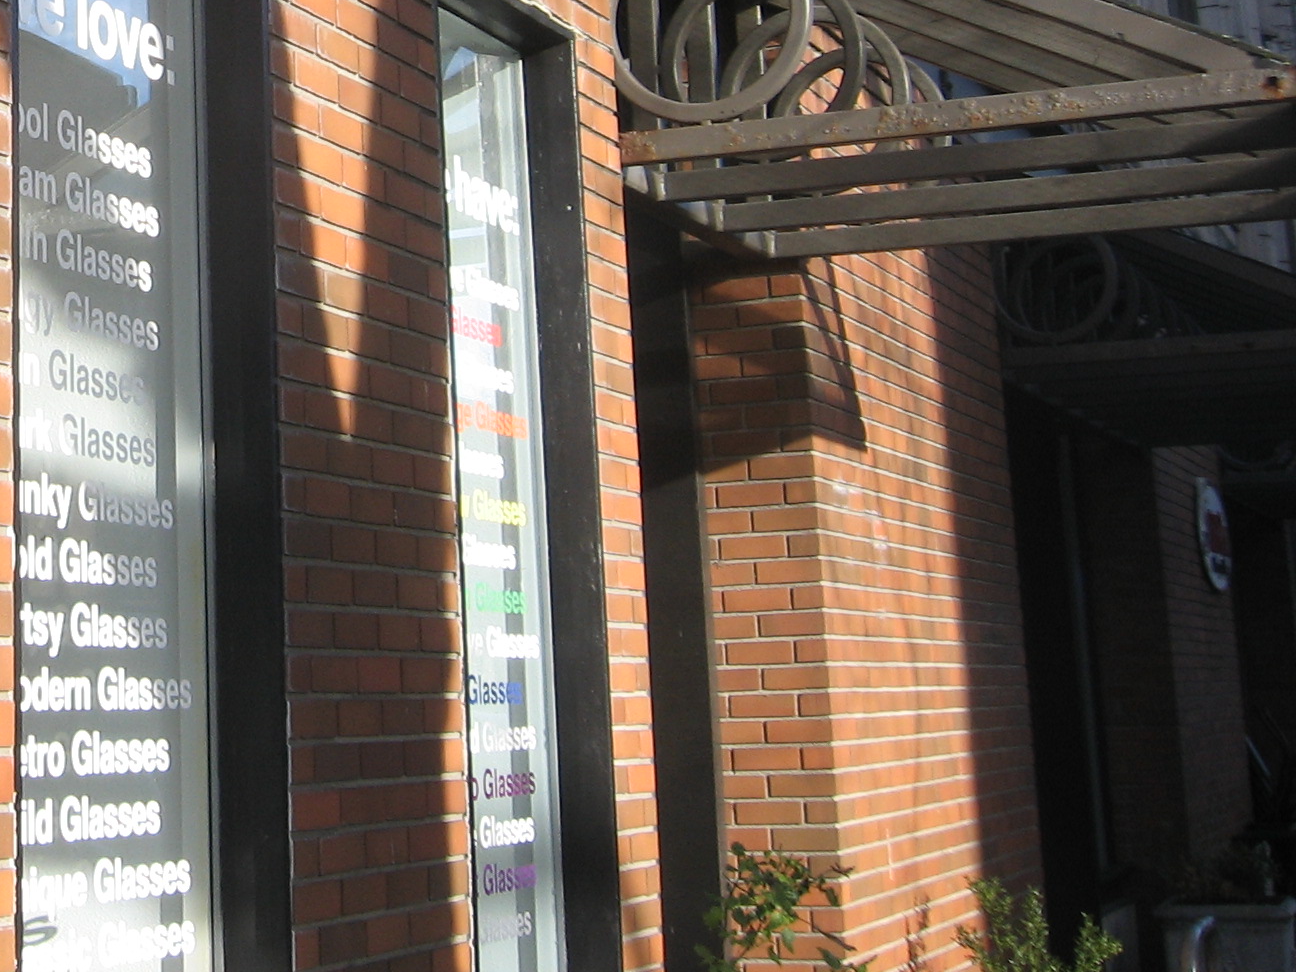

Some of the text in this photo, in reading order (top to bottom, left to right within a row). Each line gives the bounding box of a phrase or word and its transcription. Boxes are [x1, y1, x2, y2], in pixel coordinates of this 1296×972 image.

[57, 109, 153, 179] Glasses
[65, 172, 160, 237] Glasses
[55, 228, 154, 293] Glasses
[63, 291, 160, 352] Glasses
[48, 348, 146, 405] Glasses
[58, 413, 156, 468] Glasses
[475, 400, 529, 440] Glasses
[78, 480, 175, 530] Glasses
[473, 488, 527, 526] Glasses
[59, 537, 158, 588] Glasses
[70, 601, 168, 649] Glasses
[485, 625, 540, 659] Glasses
[97, 665, 192, 712] Glasses
[467, 673, 523, 705] Glasses
[71, 729, 171, 777] Glasses
[483, 722, 536, 753] Glasses
[483, 768, 536, 800] Glasses
[60, 795, 161, 843] Glasses
[480, 815, 536, 848] Glasses
[93, 856, 192, 904] Glasses
[483, 862, 537, 896] Glasses
[97, 919, 196, 969] Glasses
